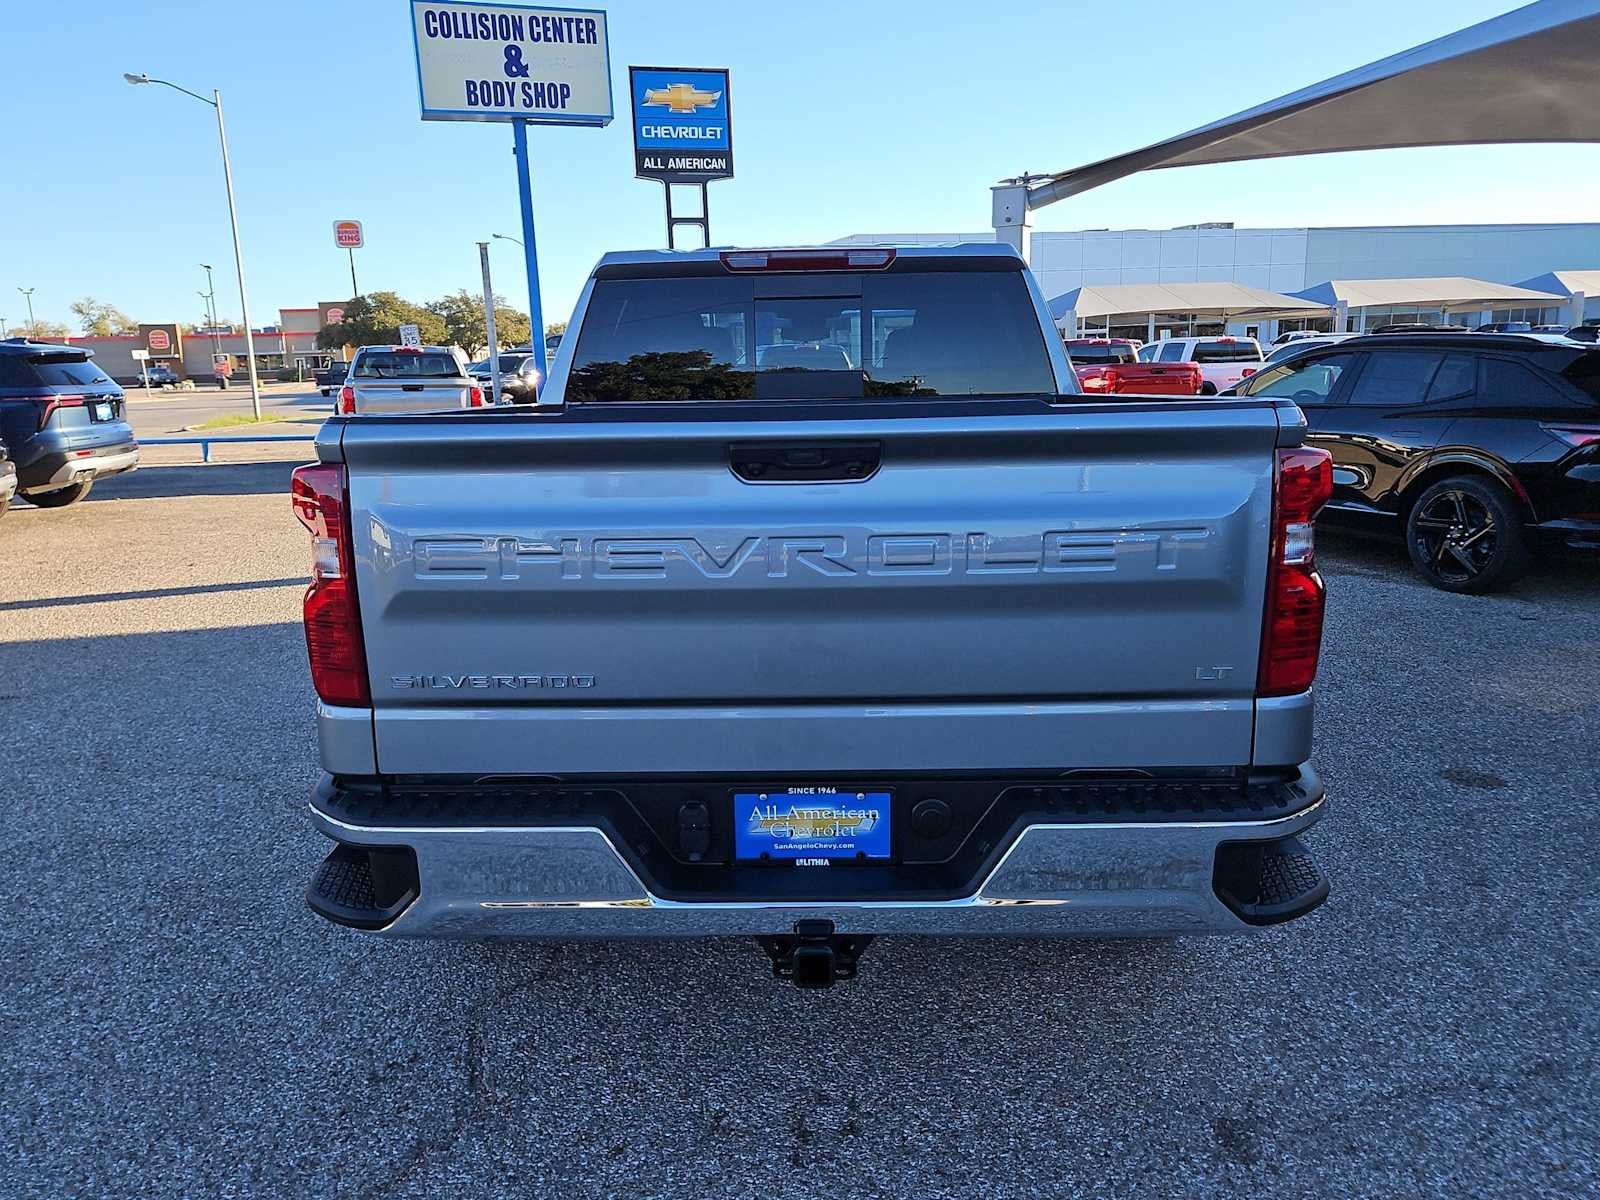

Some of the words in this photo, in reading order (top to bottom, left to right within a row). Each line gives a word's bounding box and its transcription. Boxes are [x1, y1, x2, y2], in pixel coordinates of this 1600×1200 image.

[424, 10, 524, 42] COLLISION
[529, 15, 597, 45] CENTER
[503, 44, 529, 78] &
[465, 80, 516, 108] BODY
[522, 83, 571, 109] SHOP
[642, 125, 722, 140] CHEVROLET
[643, 157, 665, 170] ALL
[667, 157, 726, 170] AMERICAN
[412, 526, 1211, 580] CHEVROLET
[391, 673, 596, 689] SILVERADO
[1194, 666, 1233, 681] LT
[788, 787, 815, 795] SINCE
[817, 787, 837, 795] 1946
[749, 805, 778, 821] All
[785, 805, 880, 820] American
[770, 820, 857, 839] Chevrolet
[773, 842, 855, 850] SanAngeloChevy.com
